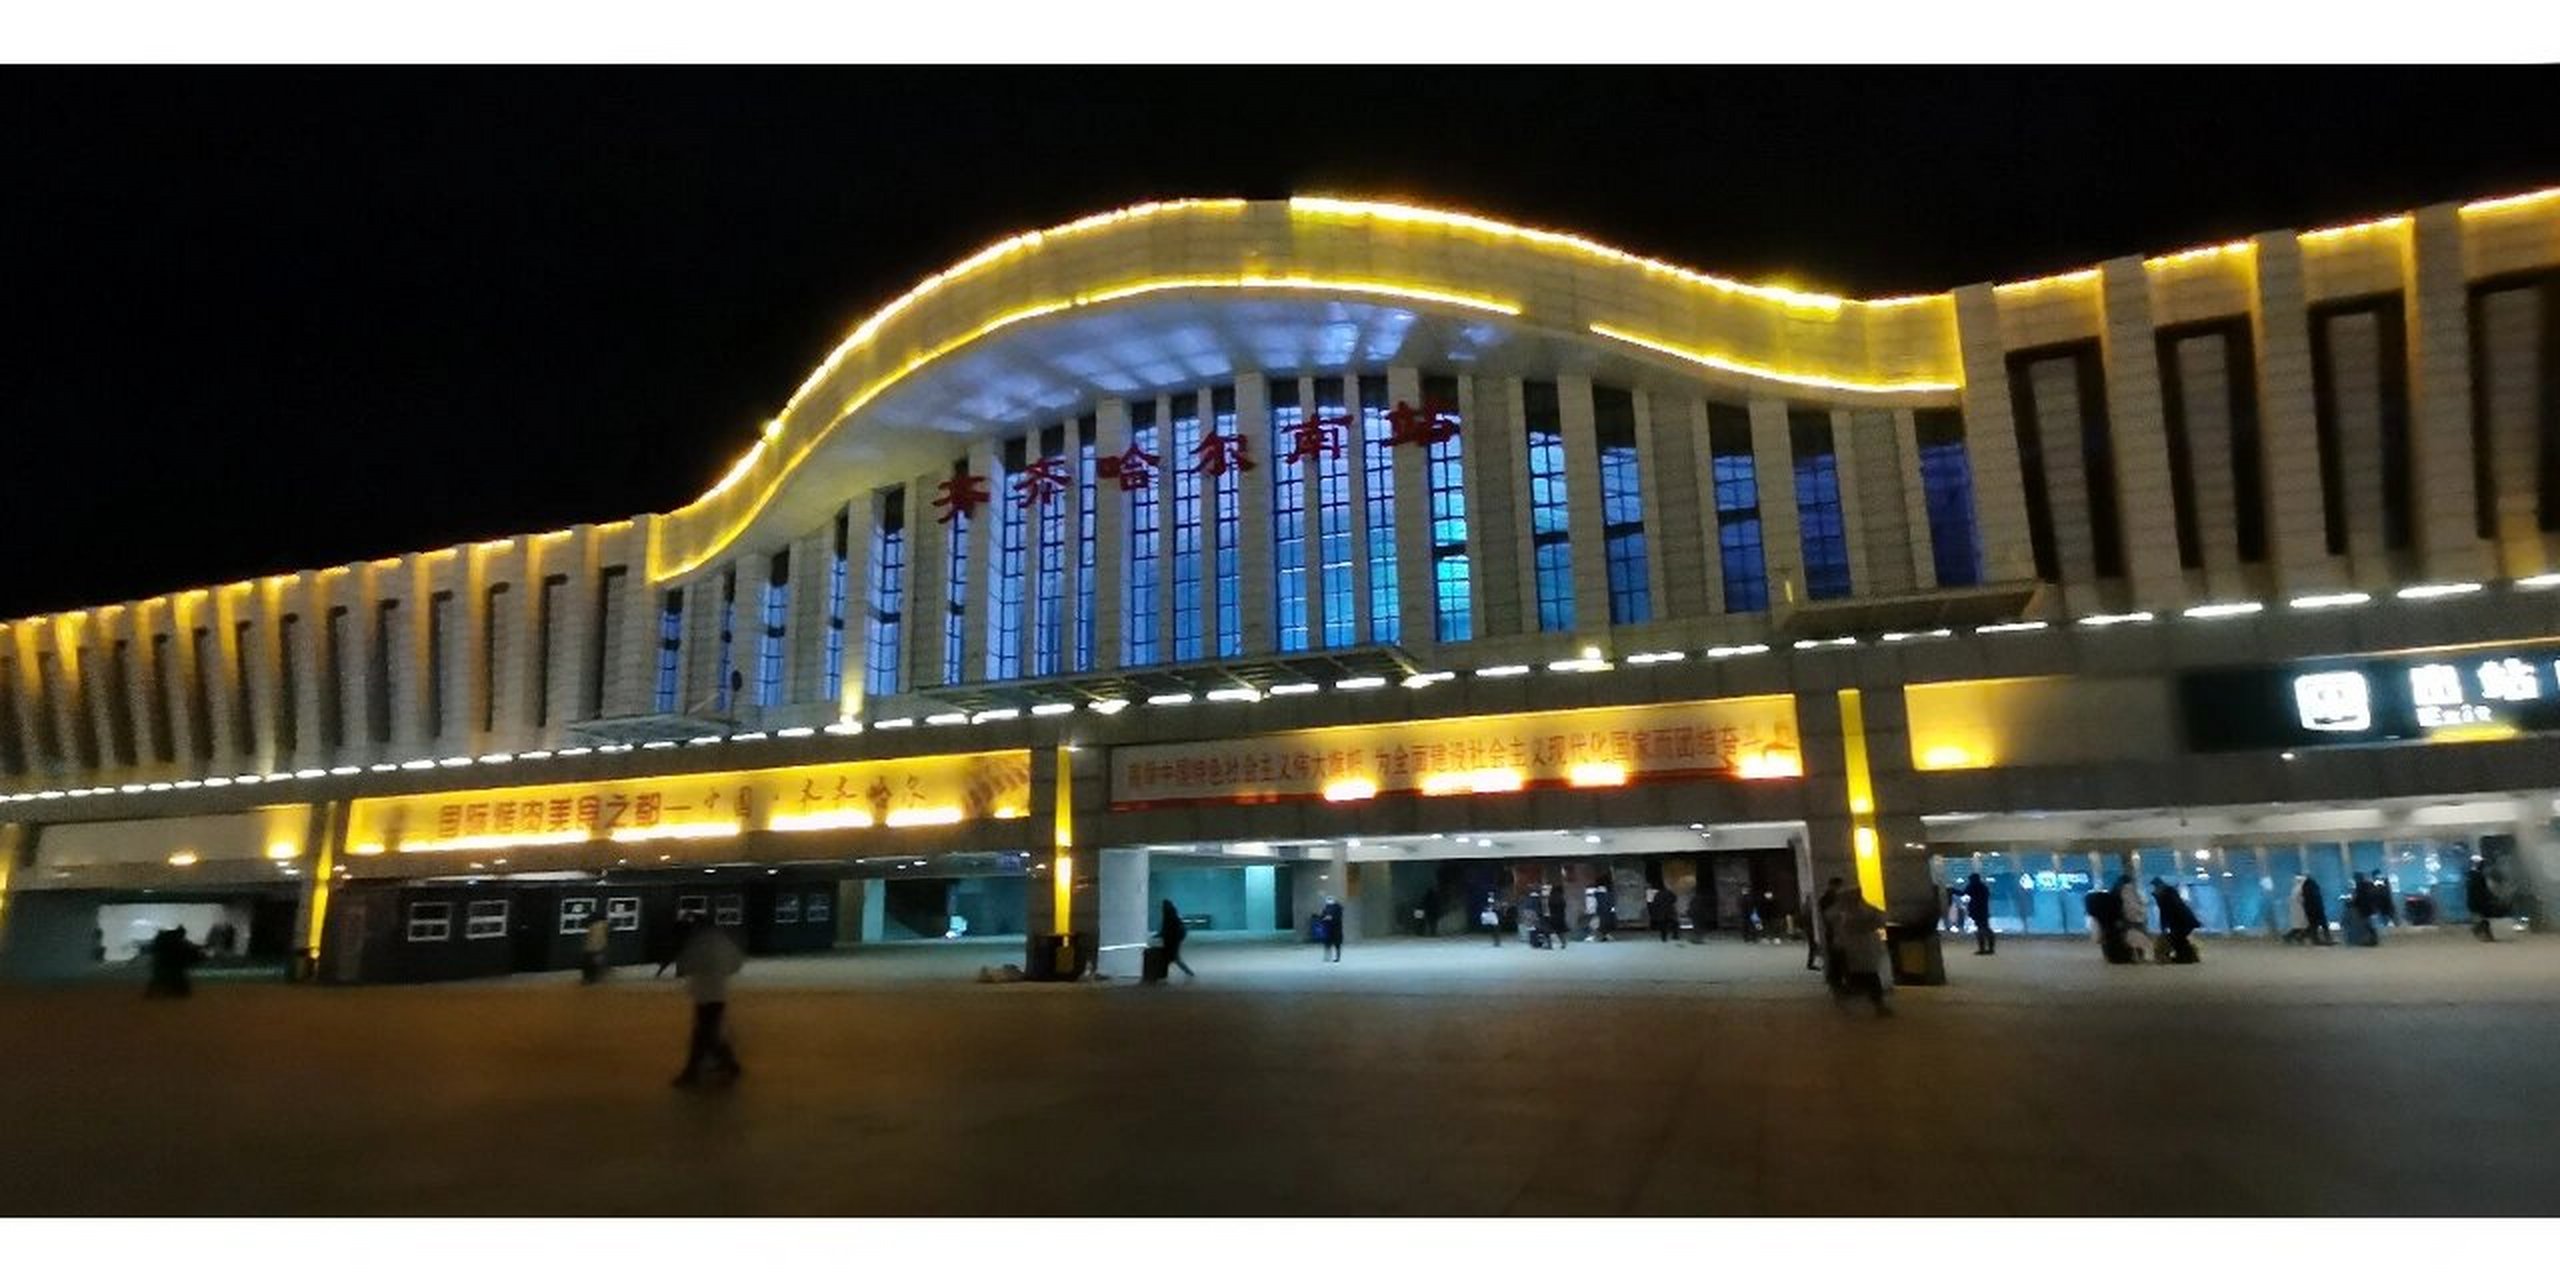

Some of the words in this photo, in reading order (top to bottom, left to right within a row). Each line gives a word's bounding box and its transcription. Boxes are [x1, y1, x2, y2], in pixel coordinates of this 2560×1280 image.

[932, 399, 1461, 524] 齐齐哈尔南站
